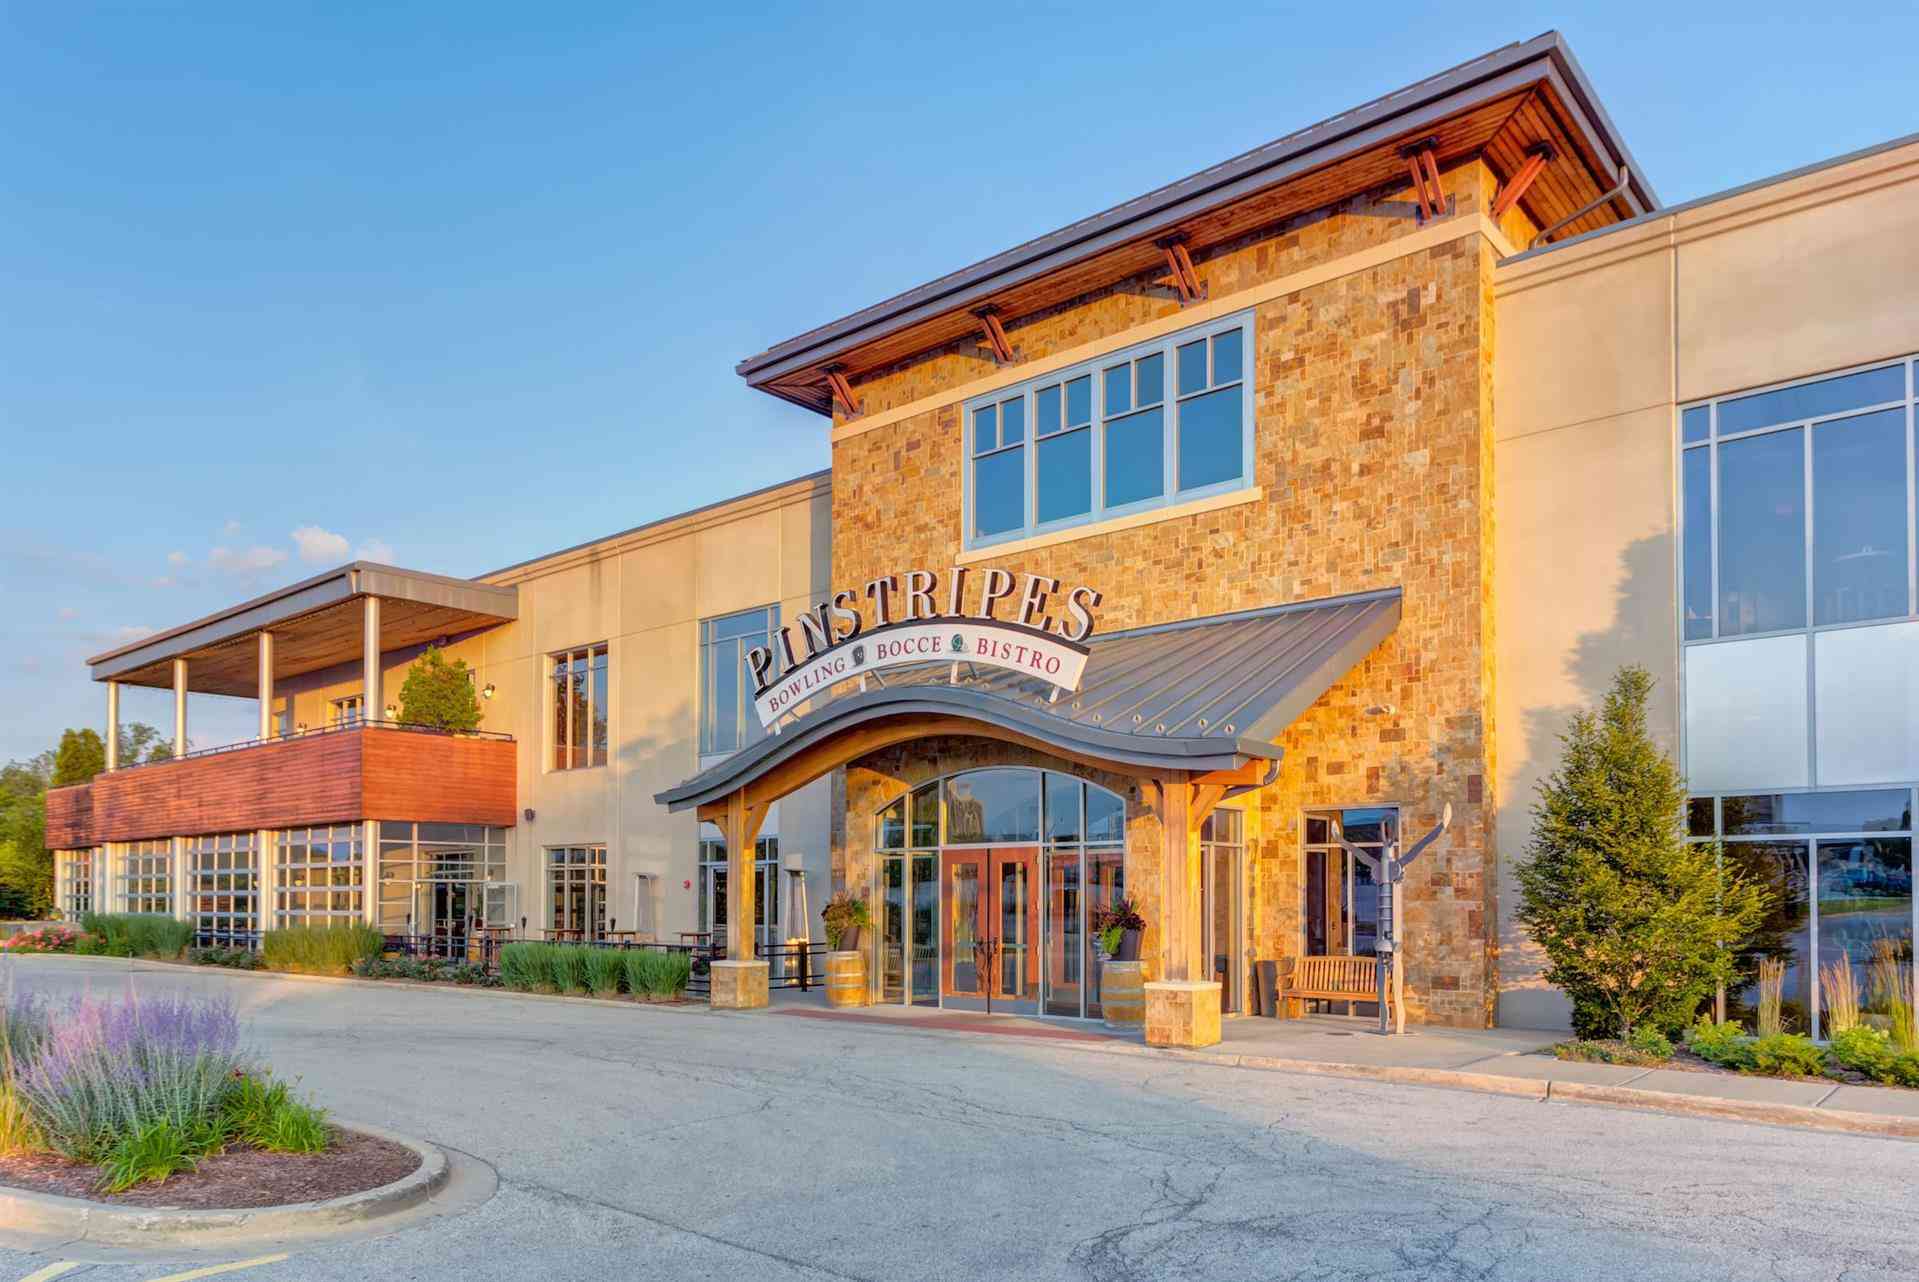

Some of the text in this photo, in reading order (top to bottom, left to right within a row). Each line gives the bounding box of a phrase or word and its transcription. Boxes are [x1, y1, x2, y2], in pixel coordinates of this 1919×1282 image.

[744, 567, 1103, 692] PINSTRIPES
[769, 635, 1061, 713] BOWLING BOCCE BISTRO
